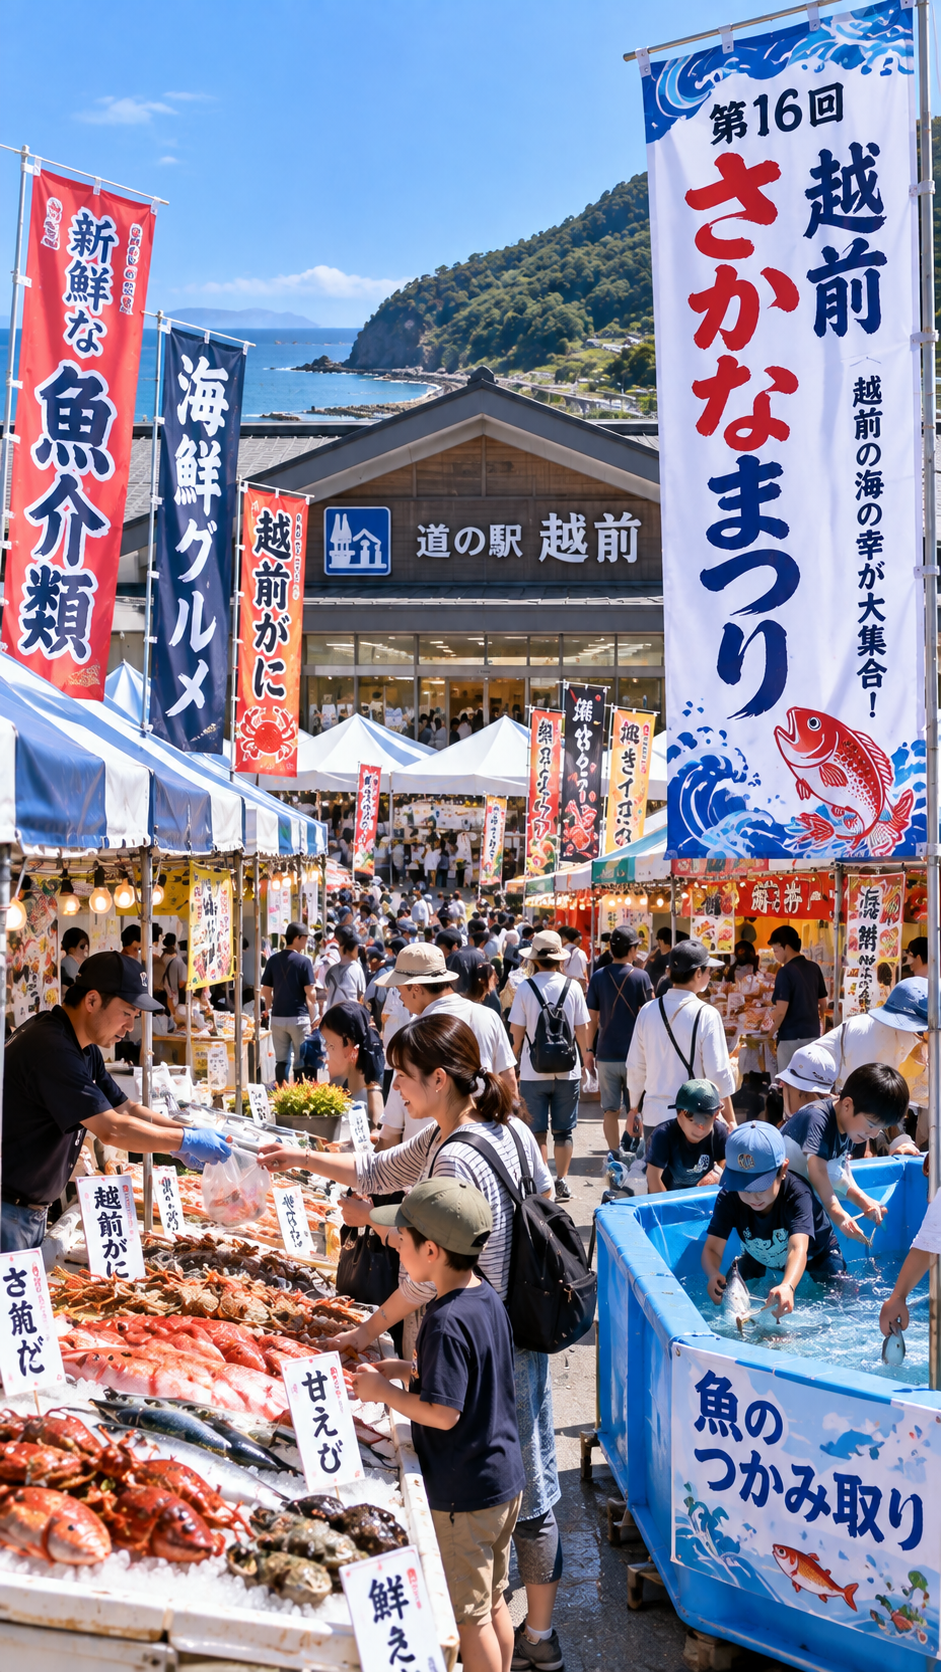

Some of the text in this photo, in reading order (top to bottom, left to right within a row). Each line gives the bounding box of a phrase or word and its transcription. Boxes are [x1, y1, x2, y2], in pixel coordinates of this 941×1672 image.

[708, 81, 844, 146] 第16回
[803, 141, 888, 338] 越前
[684, 151, 801, 720] さかなまつり
[165, 354, 230, 718] 海鮮グルメ
[416, 511, 642, 563] 道の駅 越前
[852, 375, 888, 718] 越前の海の幸が大集合！
[254, 509, 292, 699] 越前がに
[94, 1185, 130, 1279] 越前がに
[301, 1369, 343, 1475] 甘えび
[693, 1369, 784, 1446] 魚の
[693, 1447, 924, 1552] つかみ取り
[368, 1574, 417, 1672] 鮮え
